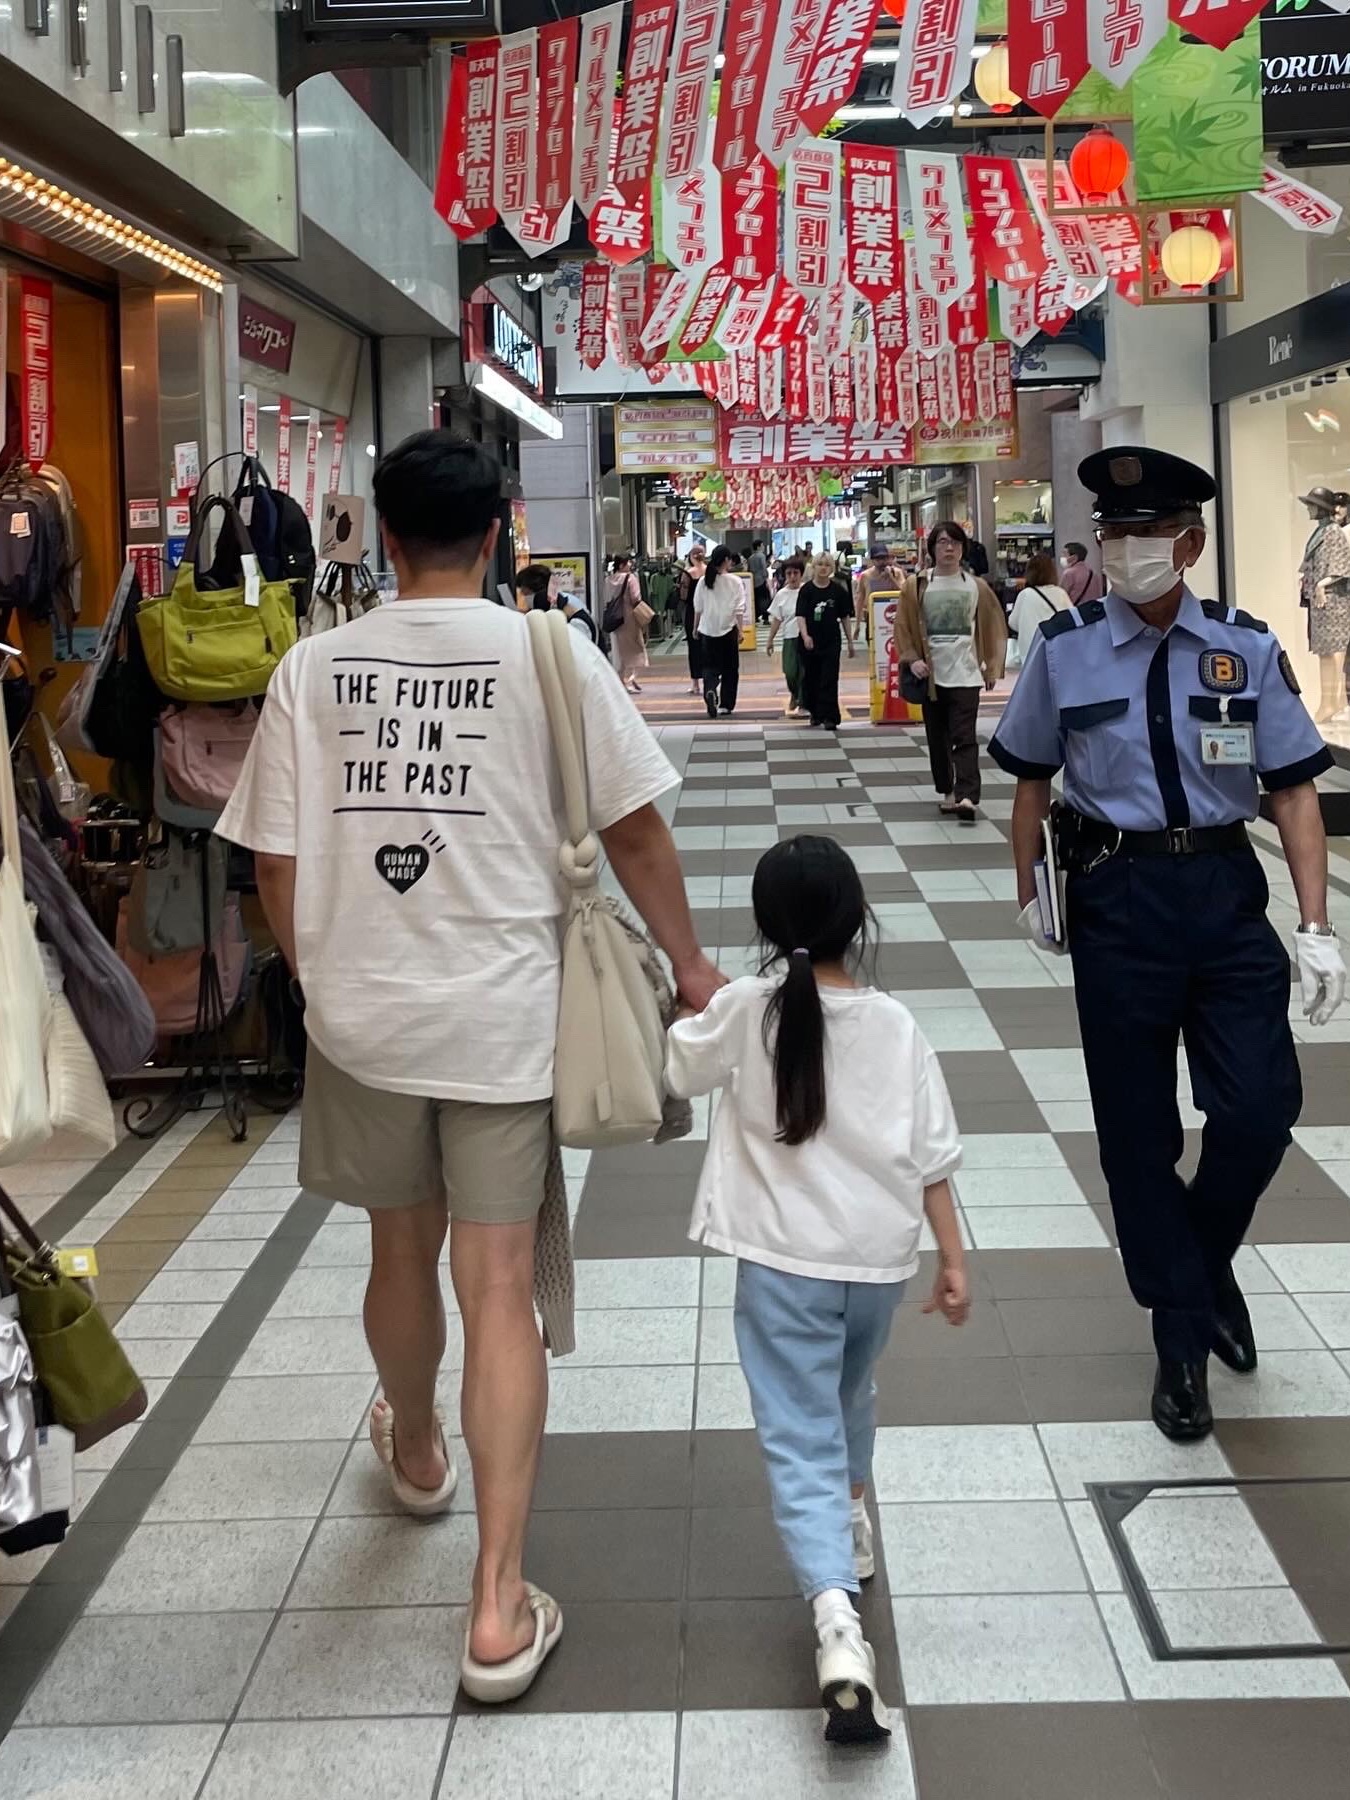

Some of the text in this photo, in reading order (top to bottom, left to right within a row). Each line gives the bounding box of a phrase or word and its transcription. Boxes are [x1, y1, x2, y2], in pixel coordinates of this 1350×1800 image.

[616, 25, 669, 184] 創業祭
[665, 7, 719, 179] 2割引
[800, 0, 876, 112] 業祭
[907, 0, 961, 110] 割引
[466, 74, 495, 210] 創業祭
[501, 64, 532, 212] 2割引
[793, 163, 834, 289] 2割引
[851, 172, 894, 287] 創業祭
[26, 312, 49, 462] 2割引
[728, 421, 908, 465] 創業祭
[873, 506, 897, 526] 本
[332, 674, 497, 710] THE FUTURE
[377, 717, 443, 752] IS IN
[343, 761, 472, 796] THE PAST
[383, 853, 421, 866] HUMAN
[387, 866, 417, 880] MADE
